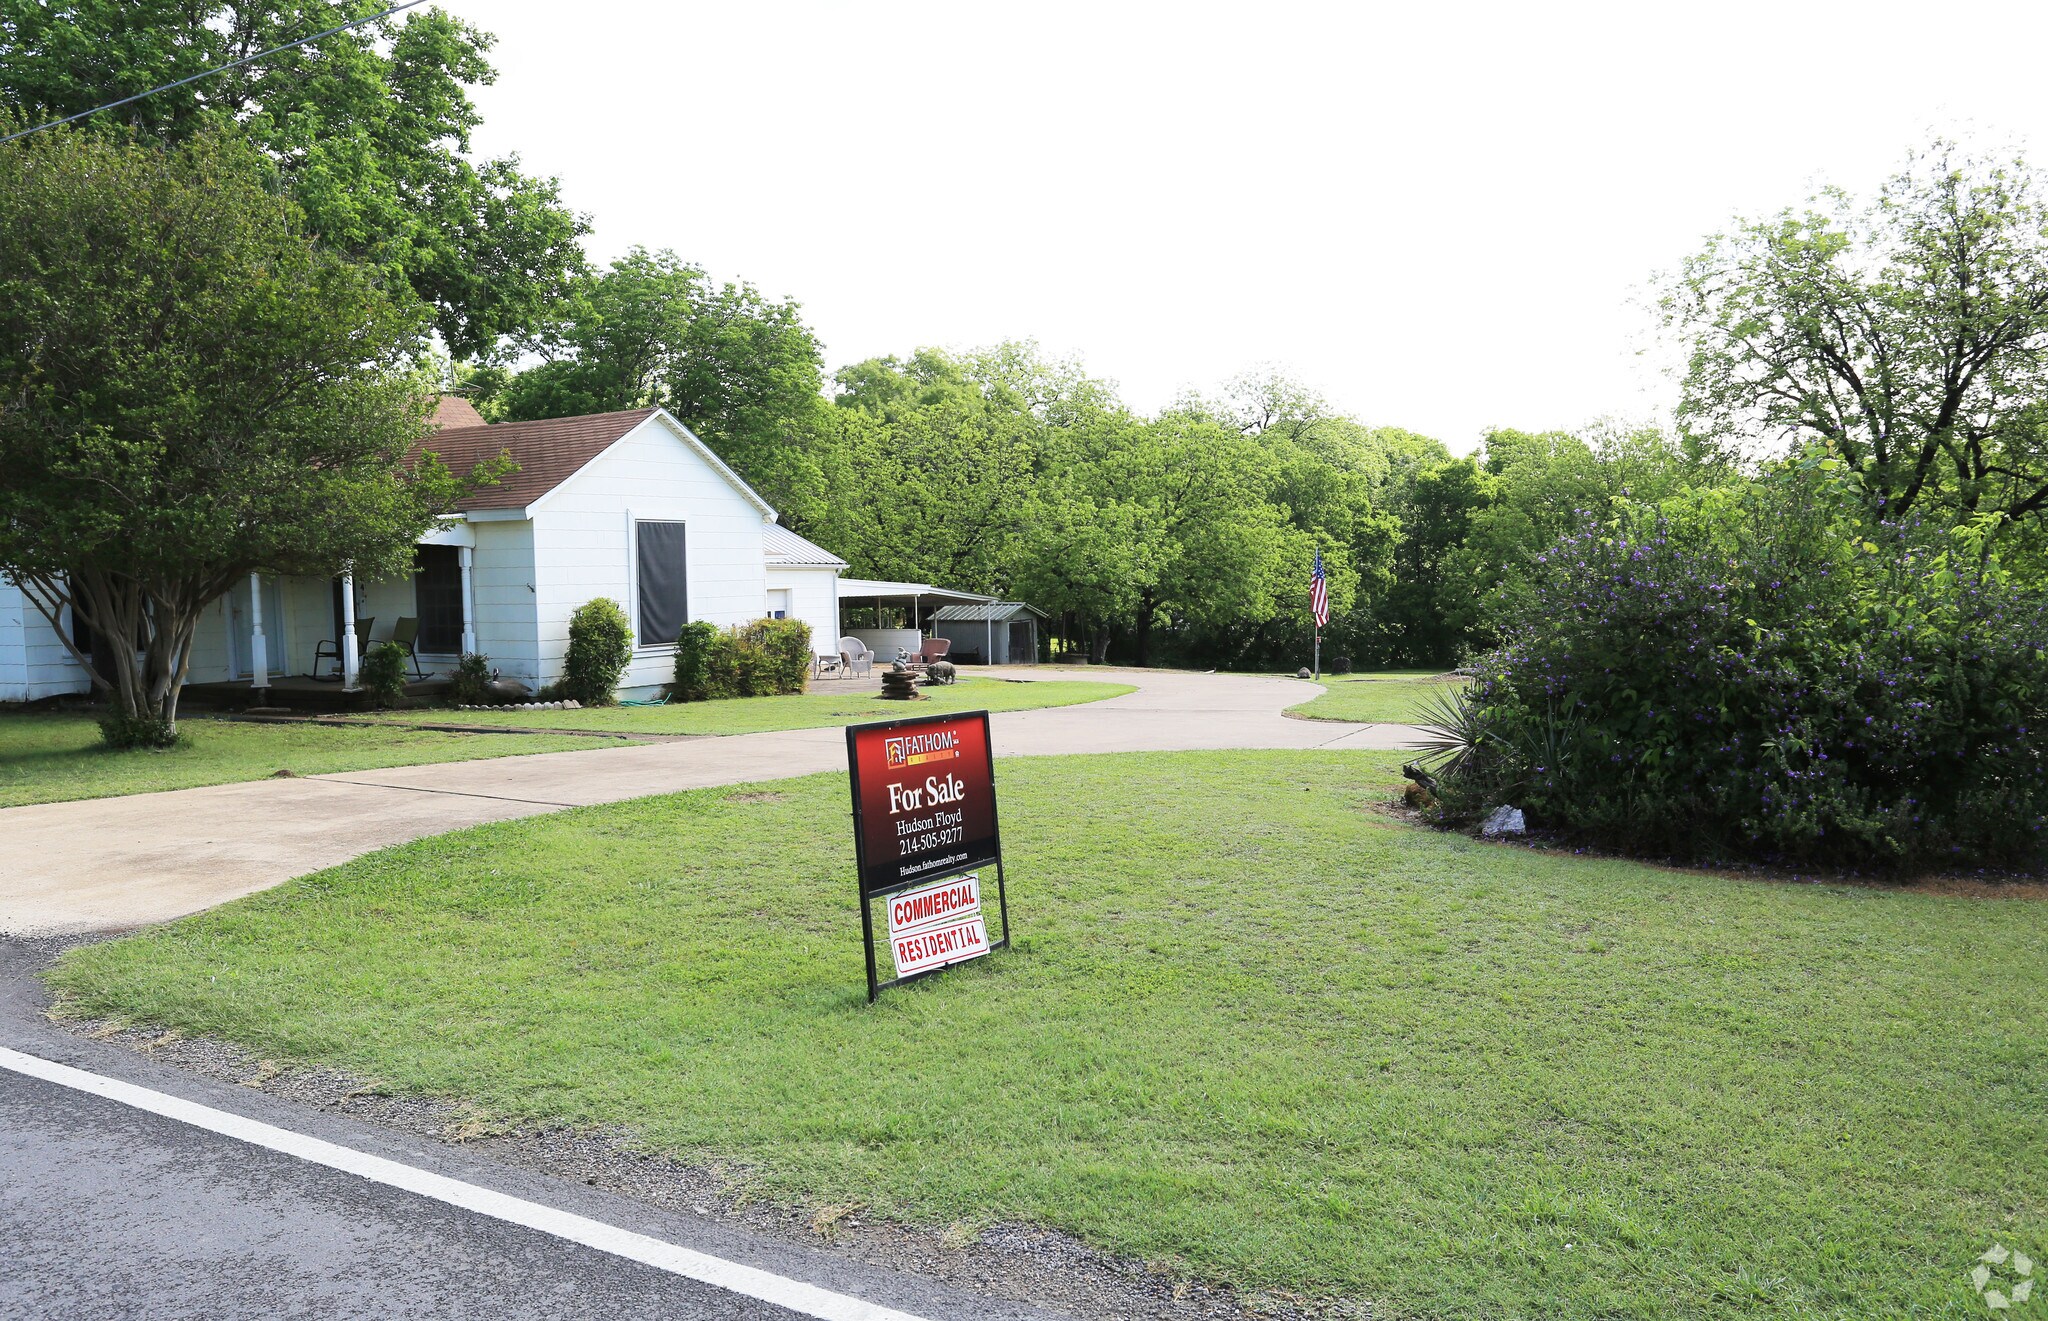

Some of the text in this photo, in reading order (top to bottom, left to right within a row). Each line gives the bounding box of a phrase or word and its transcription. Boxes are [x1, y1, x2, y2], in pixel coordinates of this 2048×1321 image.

[905, 731, 953, 755] FATHOM
[886, 773, 965, 814] For Sale
[896, 808, 962, 835] Hudson Floyd
[899, 826, 963, 855] 214-505-9277
[899, 852, 968, 876] Hudson.fathomrealty.com
[894, 884, 975, 925] COMMERCIAL
[898, 925, 980, 964] RESIDENTIAL
